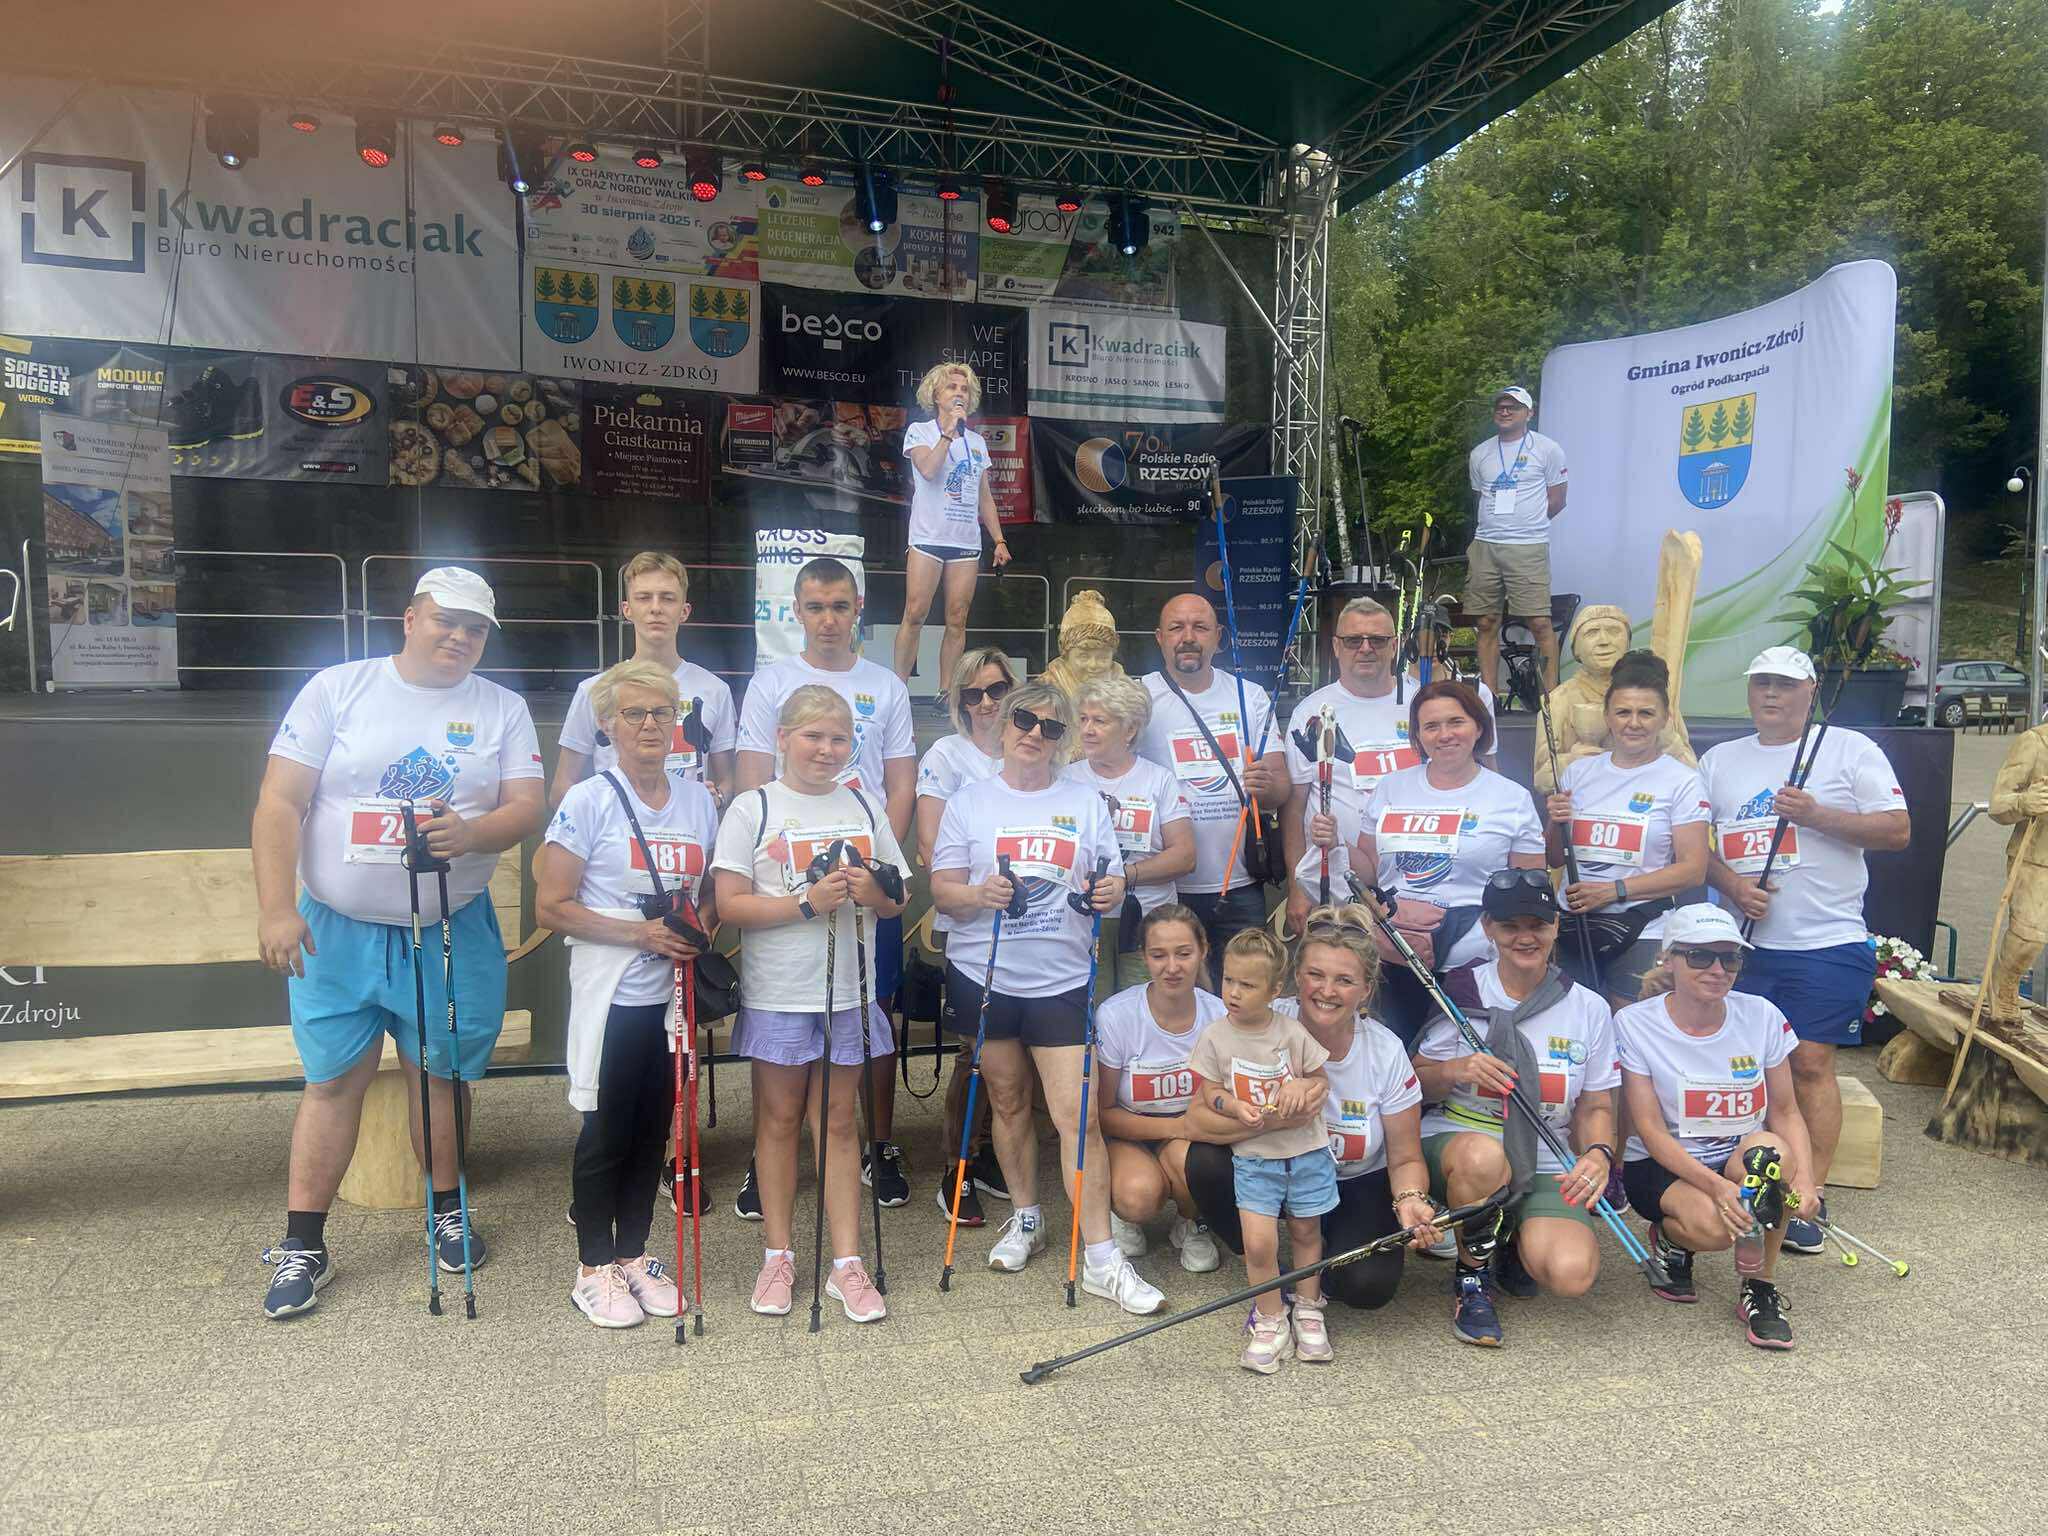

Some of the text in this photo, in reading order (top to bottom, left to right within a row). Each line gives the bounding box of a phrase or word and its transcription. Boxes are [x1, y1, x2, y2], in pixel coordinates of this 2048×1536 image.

[567, 167, 686, 190] IX CHARYTATYWNY C
[576, 178, 698, 202] ORAZ NORDIC WALKIN
[62, 187, 111, 239] K
[157, 187, 484, 257] Kwadraciak
[581, 203, 704, 228] 30 sierpnia 2025 r.
[768, 215, 817, 228] LECZENIE
[1008, 209, 1076, 240] grody
[768, 230, 841, 245] REGENERACJA
[910, 229, 967, 245] KOSMEYKI
[1153, 224, 1175, 236] 942
[157, 236, 419, 275] Biuro Nieruchomości
[768, 246, 838, 262] WYPOCZYNEK
[938, 246, 967, 257] ntury
[781, 304, 882, 342] besco
[972, 324, 1006, 344] WE
[1061, 335, 1080, 355] K
[1092, 334, 1201, 359] Kwadraciak
[1626, 320, 1805, 381] Gmina Iwonicz-Zdrój
[4, 357, 71, 381] SAFETY
[941, 347, 1006, 369] SHAPE
[4, 373, 71, 397] JOGGER
[97, 368, 165, 385] MODULO
[782, 366, 866, 384] WWW.BESCO.EU
[897, 370, 1010, 395] TH TER
[1063, 374, 1099, 384] KROSNO
[1132, 379, 1160, 388] SANOK
[1165, 382, 1191, 390] LESKO
[1670, 364, 1771, 396] Ogród Podkarpacia
[18, 394, 55, 406] WORKS
[593, 404, 704, 436] Piekarnia
[604, 430, 692, 453] Ciastkarnia
[614, 451, 683, 465] Miejsce Piastowe
[991, 457, 1025, 470] OWNIA
[1139, 453, 1217, 464] Polskie Radio
[1242, 505, 1284, 515] RZESZÓW
[1239, 573, 1281, 583] RZESZÓW
[1190, 739, 1214, 760] 15
[1376, 752, 1398, 773] 11
[1401, 815, 1441, 833] 176
[1590, 822, 1620, 847] 80
[1017, 838, 1057, 863] 147
[1743, 830, 1771, 855] 25
[647, 844, 688, 872] 181
[0, 999, 81, 1028] Zdroju
[1149, 1071, 1193, 1099] 109
[1705, 1092, 1754, 1117] 213
